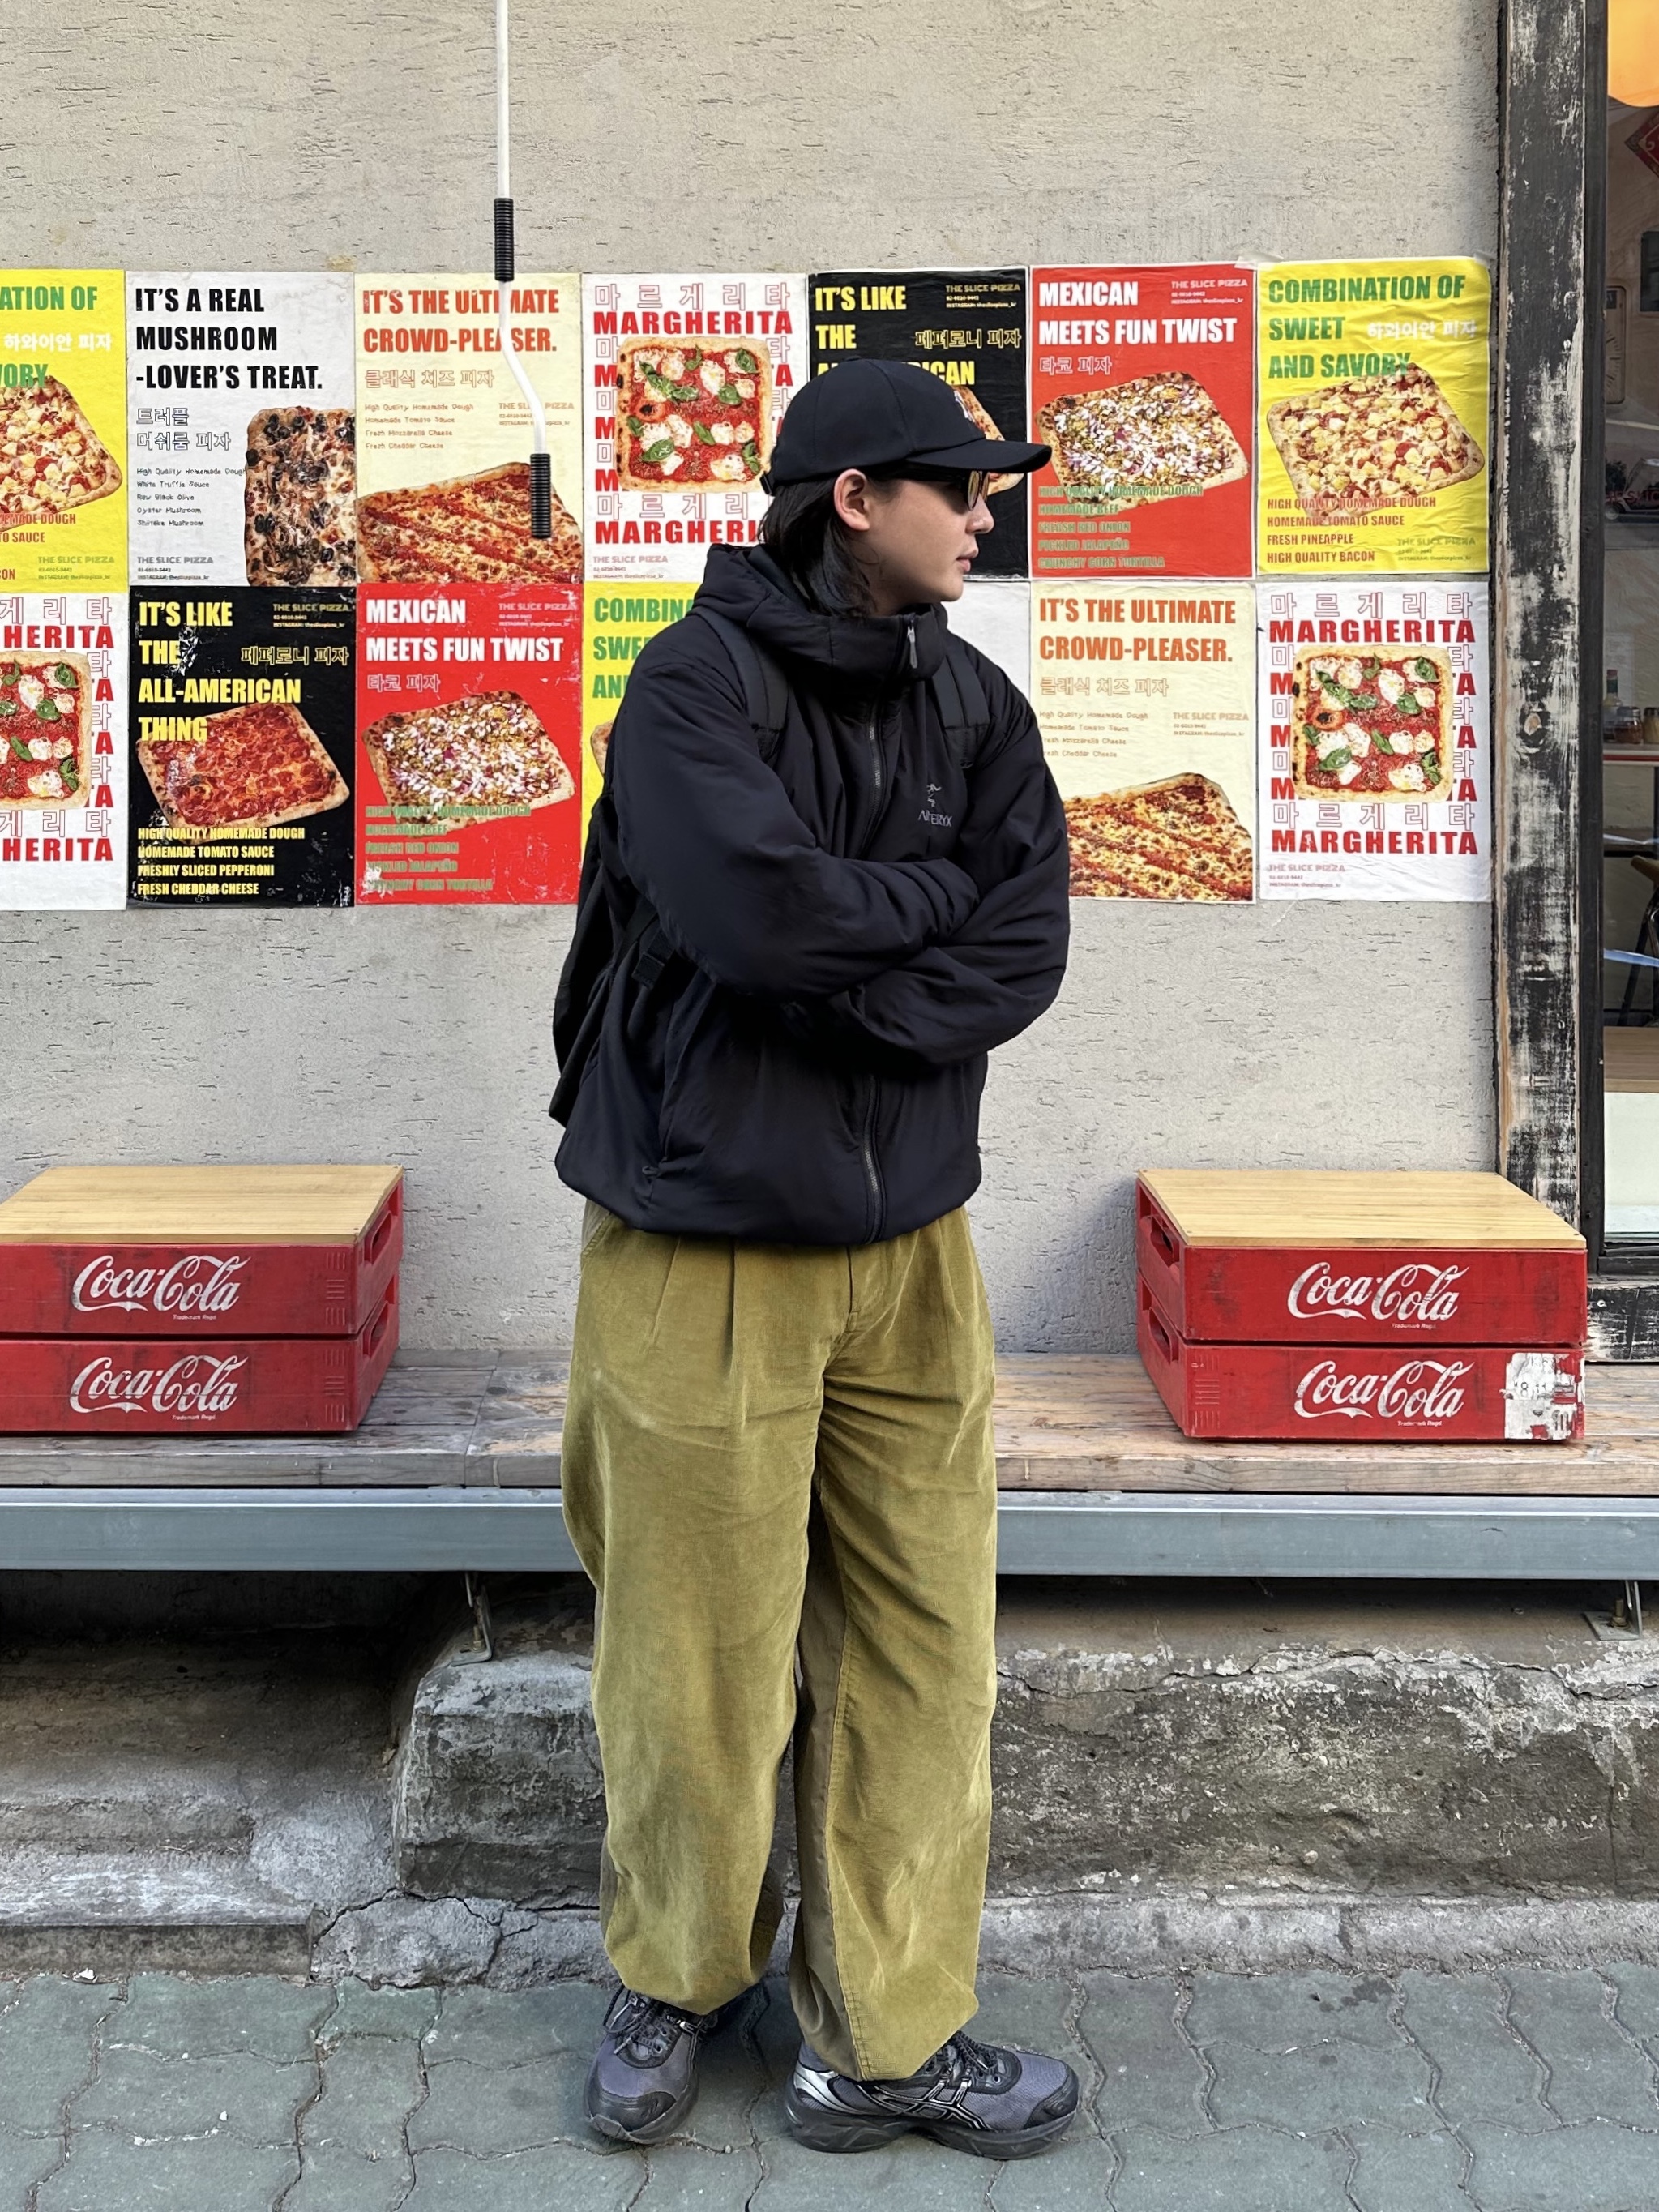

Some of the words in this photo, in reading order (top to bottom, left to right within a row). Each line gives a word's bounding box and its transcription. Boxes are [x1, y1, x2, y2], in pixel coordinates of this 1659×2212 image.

[1039, 281, 1138, 306] MEXICAN
[1171, 280, 1188, 288] THE
[1191, 280, 1216, 288] SLICE
[1217, 280, 1248, 288] PIZZA
[1268, 276, 1431, 303] COMBINATION
[1437, 275, 1466, 299] OF
[71, 286, 97, 310] OF
[135, 288, 179, 312] IT'S
[186, 288, 202, 312] A
[209, 288, 265, 312] REAL
[363, 290, 404, 314] IT'S
[408, 290, 450, 314] THE
[815, 286, 856, 311] IT'S
[861, 286, 906, 311] LIKE
[593, 311, 793, 334] MARGHERITA
[1039, 319, 1110, 344] MEETS
[1114, 319, 1157, 344] FUN
[1161, 319, 1238, 344] TWIST
[1268, 316, 1345, 340] SWEET
[1367, 321, 1436, 340] 하와이안
[1443, 321, 1477, 340] 피자
[4, 333, 72, 352] 하와이안
[78, 333, 112, 352] 피자
[136, 327, 278, 351] MUSHROOM
[815, 324, 857, 349] THE
[915, 328, 981, 349] 페퍼로니
[987, 328, 1022, 349] 피자
[0, 364, 48, 388] ORY
[136, 365, 240, 389] -LOVER'S
[247, 365, 323, 389] TREAT.
[1040, 356, 1073, 375] 타코
[1078, 356, 1112, 375] 피자
[1268, 353, 1315, 378] AND
[1320, 353, 1411, 378] SAVORY
[365, 370, 416, 388] 클래식
[421, 370, 455, 388] 치즈
[460, 370, 495, 388] 피자
[136, 407, 190, 426] 트러플
[136, 431, 190, 451] 머쉬룸
[196, 431, 231, 451] 피자
[1267, 498, 1292, 509] HIGH
[1294, 498, 1336, 509] QUALITY
[1339, 498, 1397, 509] HOMEMADE
[1400, 498, 1436, 509] DOUGH
[41, 513, 76, 524] DOUGH
[1267, 516, 1325, 527] HOMEMADE
[1328, 516, 1368, 527] TOMATO
[1371, 516, 1405, 527] SAUCE
[12, 532, 45, 543] SAUCE
[1267, 534, 1298, 545] FRESH
[1301, 534, 1353, 545] PINEAPPLE
[1267, 552, 1292, 563] HIGH
[1294, 552, 1336, 563] QUALITY
[1339, 552, 1375, 563] BACON
[139, 602, 181, 627] IT'S
[186, 602, 233, 627] LIKE
[366, 599, 466, 623] MEXICAN
[1040, 598, 1080, 623] IT'S
[1084, 598, 1125, 623] THE
[1131, 598, 1236, 623] ULTIMATE
[1269, 620, 1476, 643] MARGHERITA
[139, 640, 181, 664] THE
[242, 646, 309, 665] 페퍼로니
[314, 646, 349, 665] 피자
[366, 637, 438, 661] MEETS
[443, 637, 485, 661] FUN
[490, 637, 564, 661] TWIST
[1040, 636, 1233, 662] CROWD-PLEASER.
[138, 678, 301, 703] ALL-AMERICAN
[367, 674, 401, 692] 타코
[406, 674, 441, 692] 피자
[1041, 678, 1091, 696] 클래식
[1097, 678, 1130, 696] 치즈
[1135, 678, 1169, 696] 피자
[138, 717, 207, 741] THING
[138, 828, 163, 839] HIGH
[165, 828, 207, 839] QUALITY
[210, 828, 267, 839] HOMEMADE
[269, 828, 305, 839] DOUGH
[1272, 830, 1478, 854] MARGHERITA
[138, 846, 195, 858] HOMEMADE
[198, 846, 239, 858] TOMATO
[241, 846, 274, 858] SAUCE
[138, 865, 180, 876] FRESHLY
[182, 865, 216, 876] SLICED
[219, 865, 274, 876] PEPPERONI
[138, 884, 169, 895] FRESH
[171, 884, 220, 895] CHEDDAR
[221, 884, 259, 895] CHEESE
[71, 1255, 251, 1311] Coca-Cola
[1287, 1261, 1470, 1320] Coca-Cola
[70, 1355, 249, 1413] Coca-Cola
[1293, 1360, 1475, 1418] Coca-Cola
